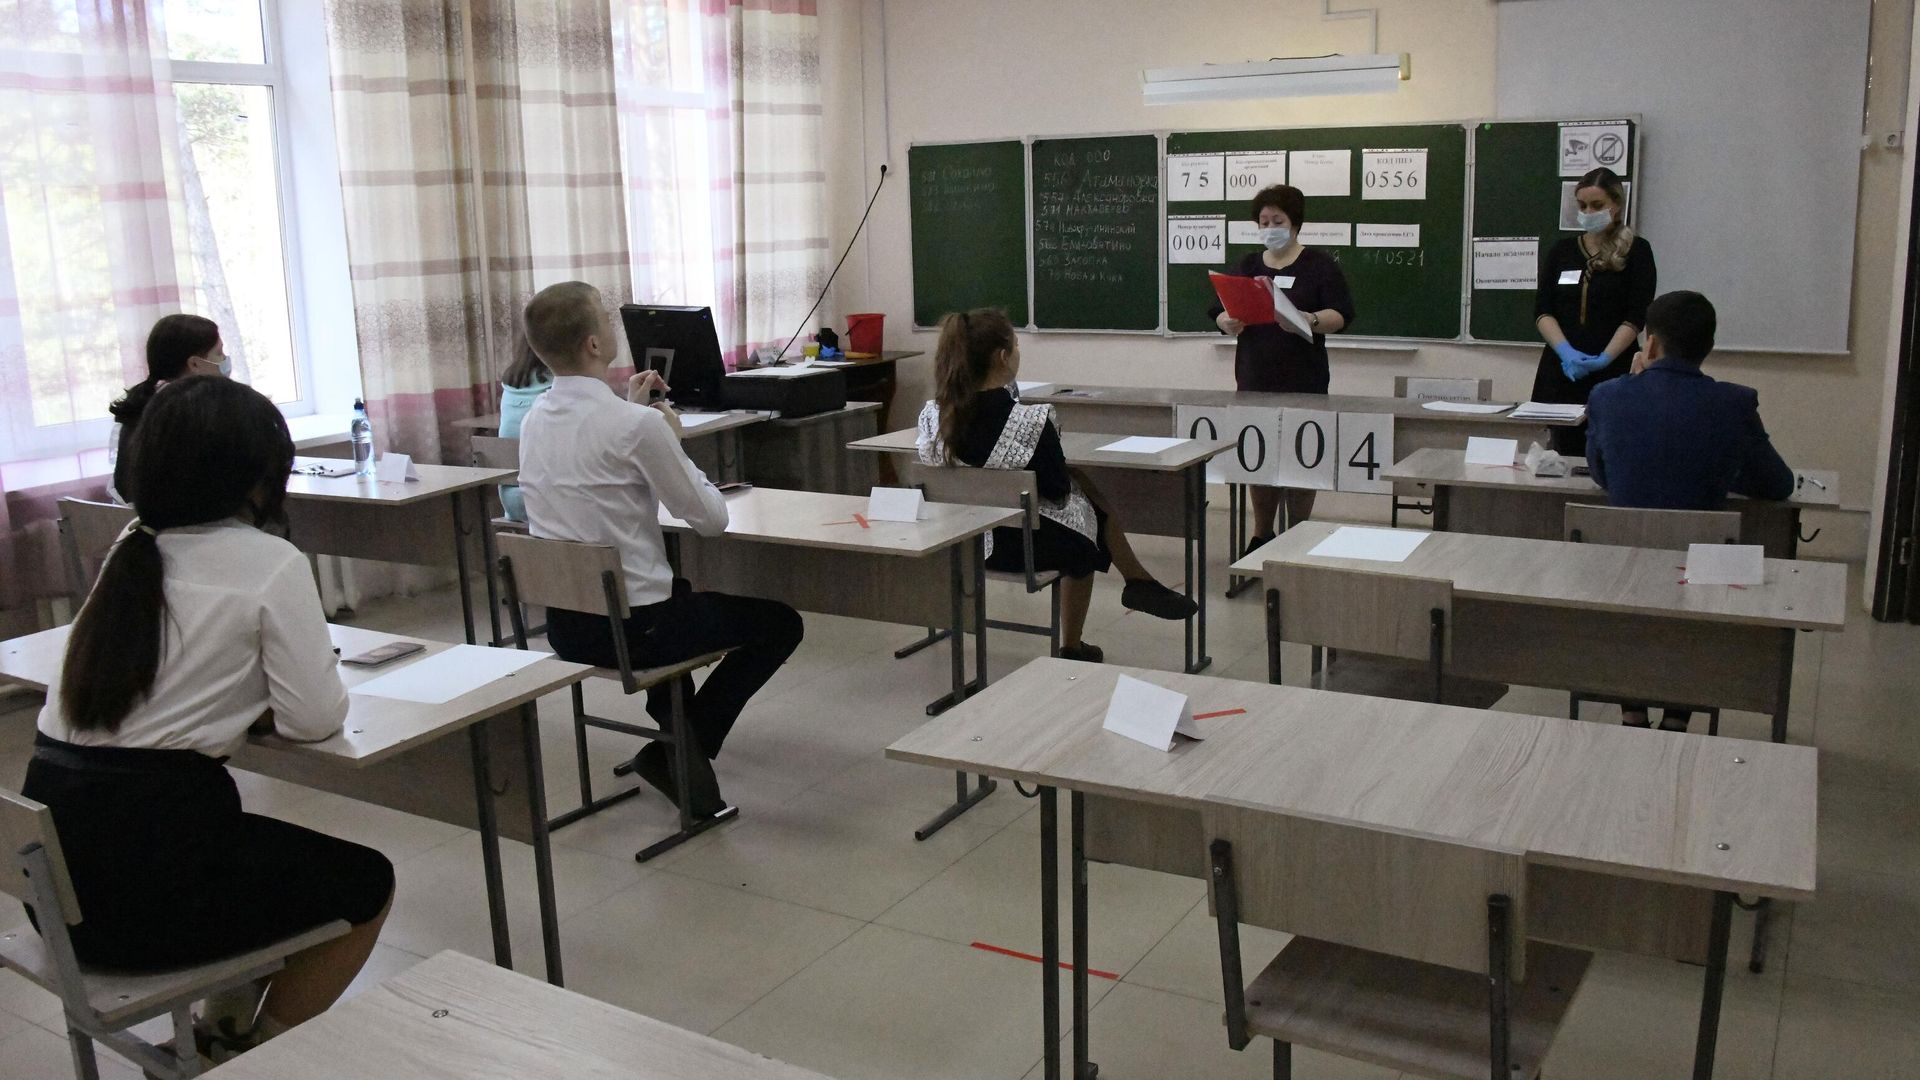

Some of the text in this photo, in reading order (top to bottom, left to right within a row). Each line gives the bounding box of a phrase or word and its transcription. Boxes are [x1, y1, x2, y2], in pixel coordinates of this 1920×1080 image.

[1230, 173, 1257, 188] 000
[1365, 170, 1418, 188] 0556
[1172, 234, 1221, 251] 0004
